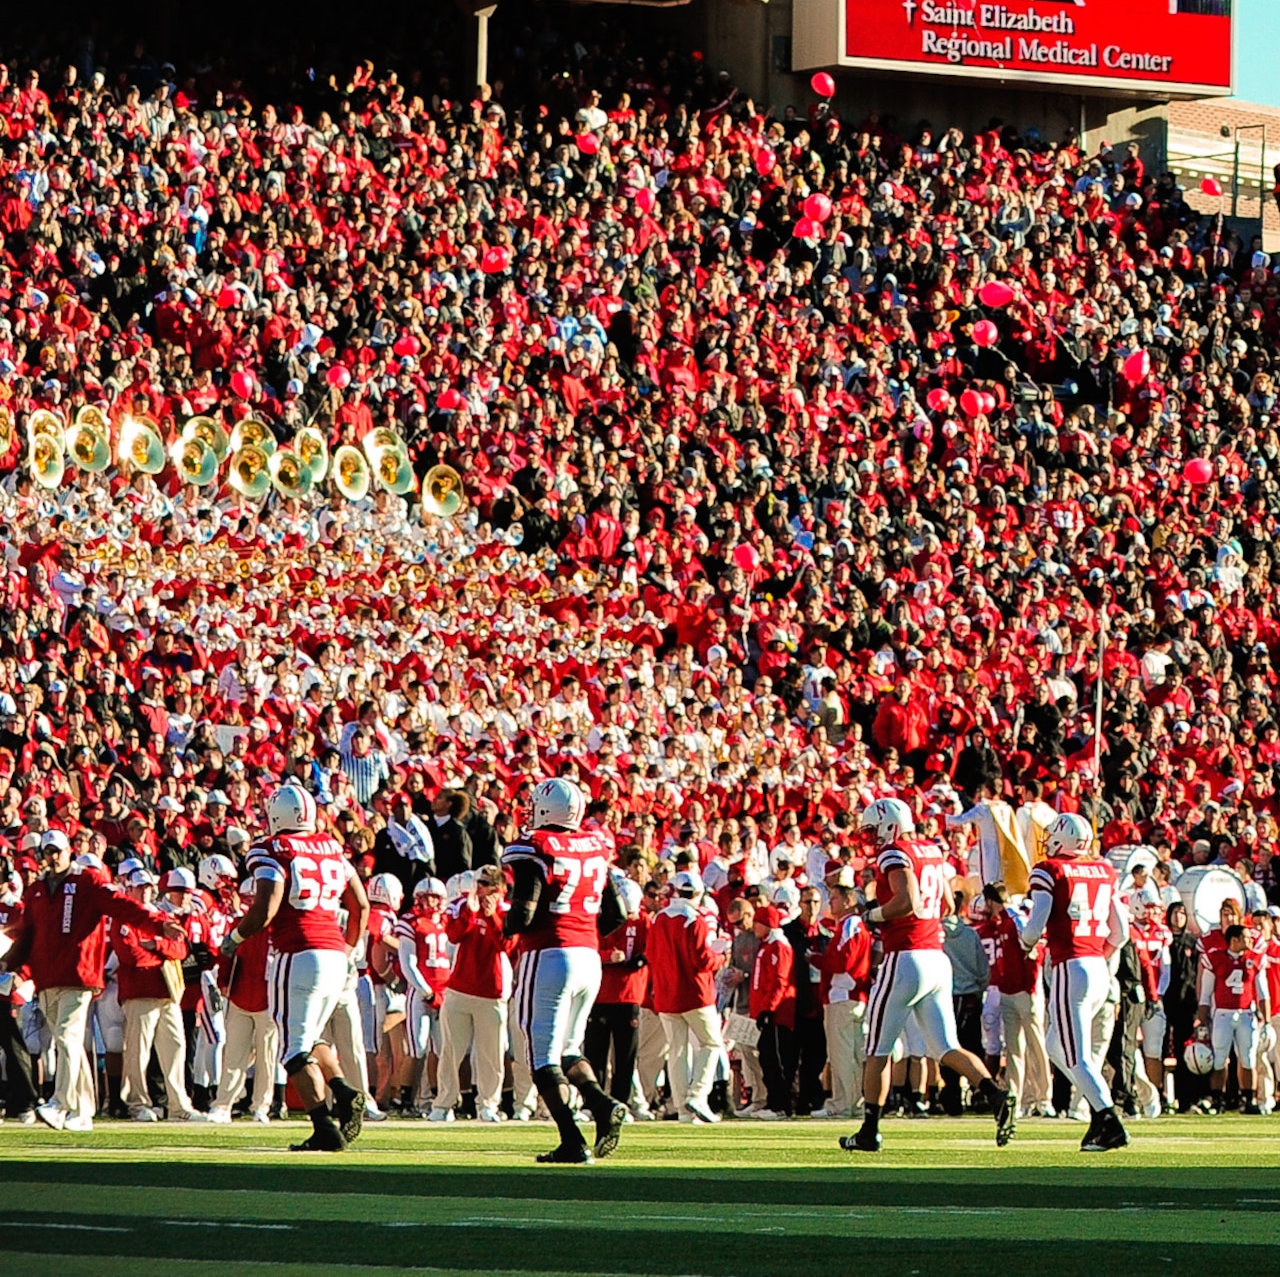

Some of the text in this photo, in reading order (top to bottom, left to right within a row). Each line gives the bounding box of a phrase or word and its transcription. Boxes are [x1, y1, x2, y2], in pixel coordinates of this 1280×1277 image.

[921, 0, 1074, 34] Saint Elizabeth
[921, 29, 1172, 72] Regional Medical Center
[567, 836, 602, 852] JONES
[289, 856, 346, 911] 68
[549, 856, 609, 914] 73
[1062, 863, 1109, 879] McNEILL
[64, 883, 77, 894] N
[1067, 882, 1113, 937] 44
[1225, 969, 1245, 995] 4
